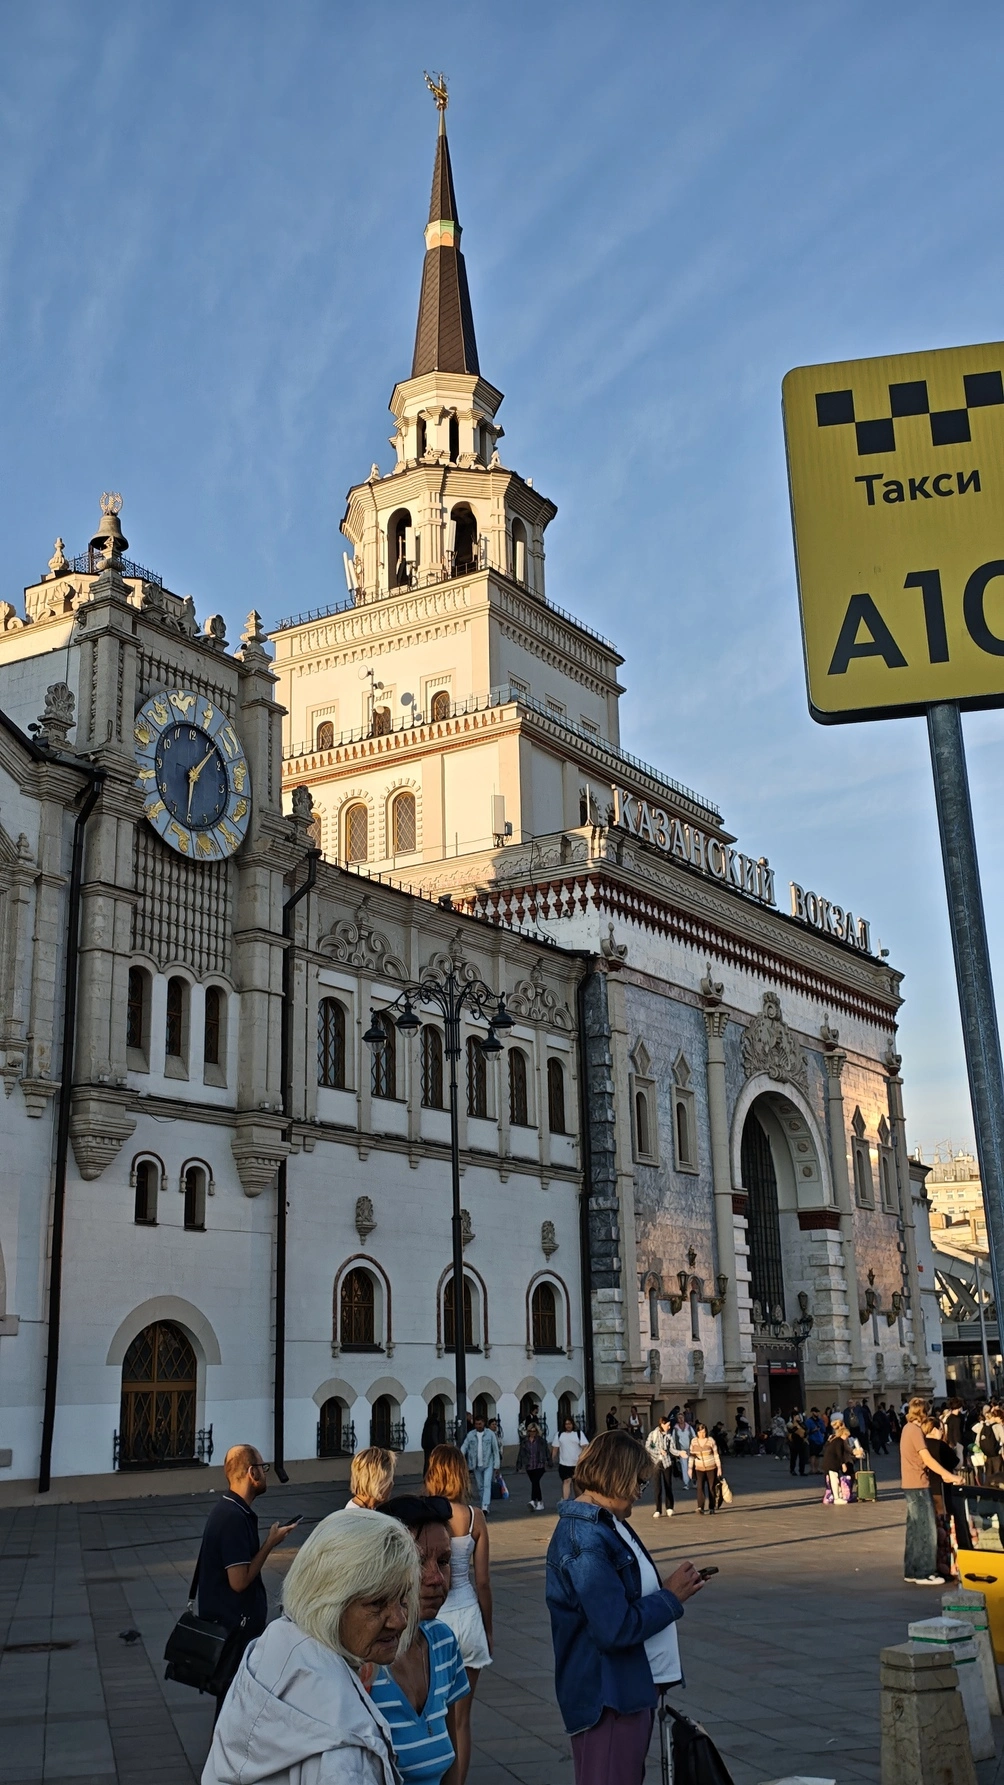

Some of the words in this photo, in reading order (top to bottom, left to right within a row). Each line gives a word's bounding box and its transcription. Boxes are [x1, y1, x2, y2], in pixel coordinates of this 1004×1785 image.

[854, 469, 982, 506] Такси
[174, 727, 181, 740] 11
[188, 729, 197, 741] 12
[163, 738, 171, 750] 10
[156, 757, 163, 769] 9
[216, 760, 221, 771] 2
[162, 782, 167, 793] 8
[218, 784, 225, 794] 3
[186, 813, 192, 824] 6
[611, 783, 777, 907] КАЗАНСКИЙ
[789, 880, 873, 955] ВОКЗАЛ
